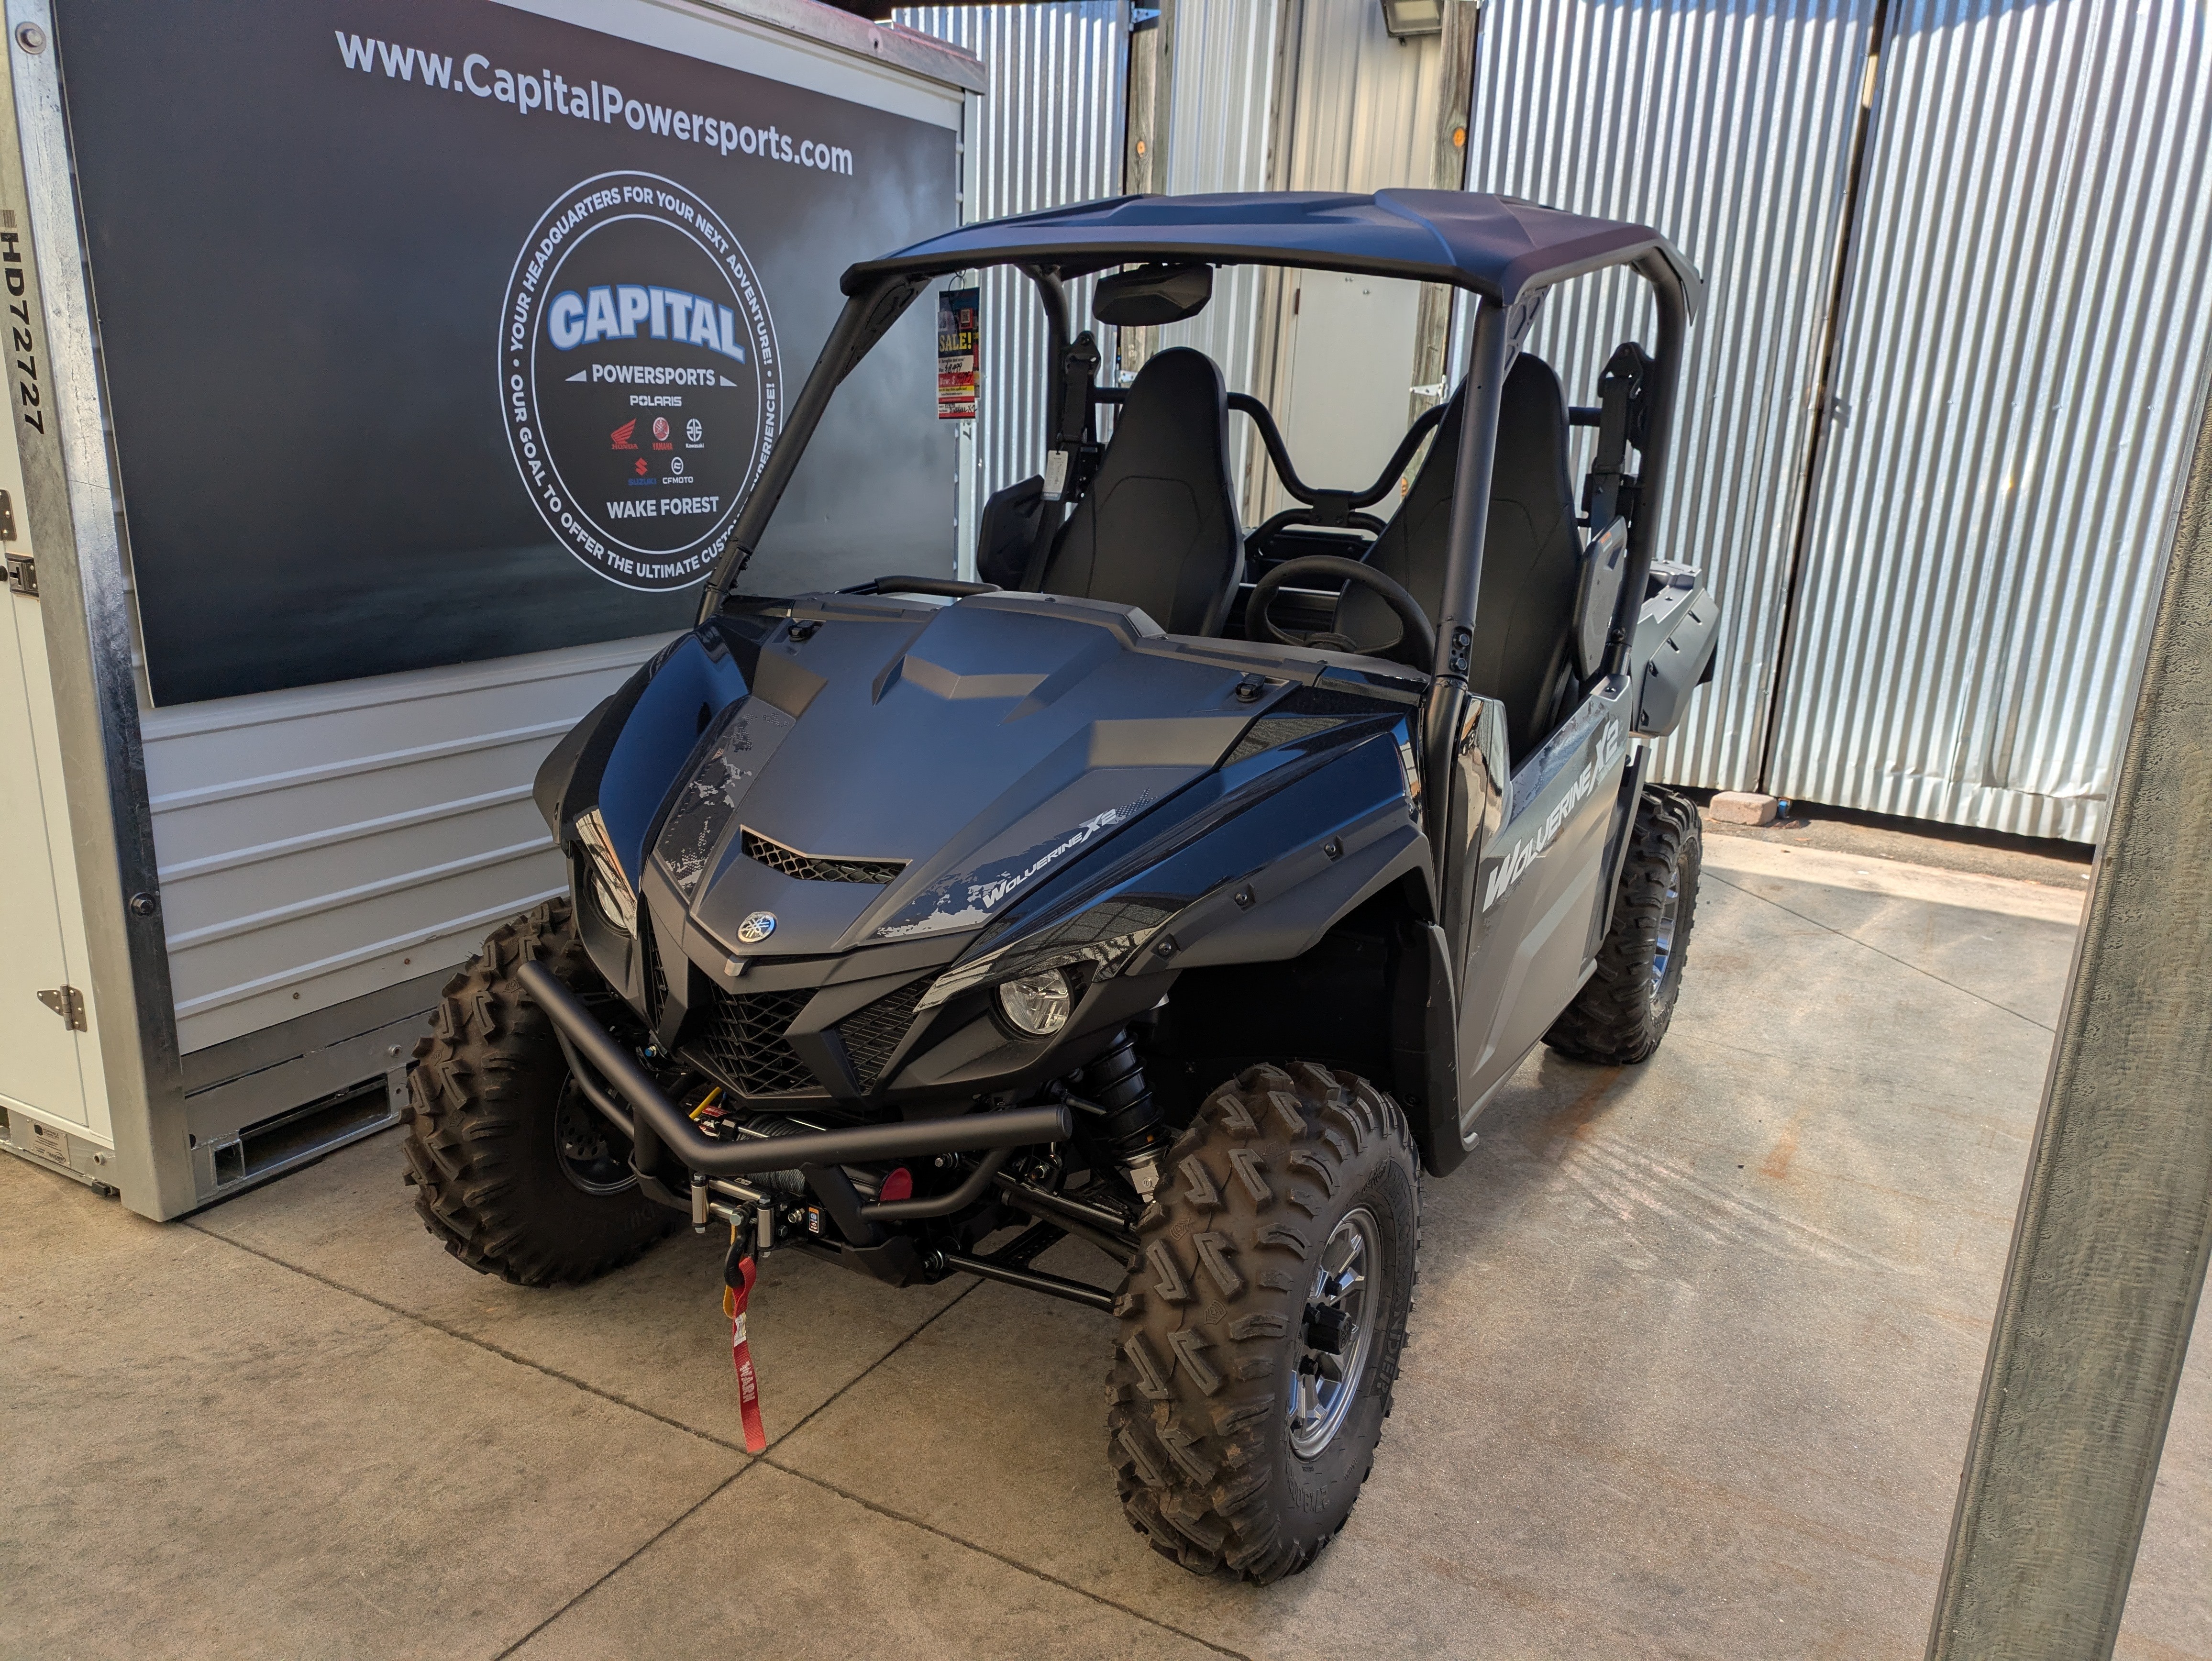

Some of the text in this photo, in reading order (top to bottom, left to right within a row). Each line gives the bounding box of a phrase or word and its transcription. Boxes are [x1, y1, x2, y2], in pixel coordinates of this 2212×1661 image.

[334, 30, 853, 176] www.CapitalPowersports.com
[510, 186, 773, 365] YOUR HEADQUARTERS FOR YOUR NEXT ADVENTURE!
[0, 233, 44, 435] HD72727
[548, 284, 746, 364] CAPITAL
[940, 332, 972, 352] SALE!
[592, 364, 716, 387] POWERSPORTS
[630, 395, 682, 407] POLARIS
[652, 442, 673, 450] YAMAHA
[510, 375, 528, 422] OUR
[519, 426, 544, 487] GOAL
[543, 483, 563, 513] TO
[561, 513, 605, 560] OFFER
[607, 550, 634, 575] THE
[636, 555, 700, 578] ULTIMATE
[606, 496, 719, 519] WAKE FOREST
[740, 1361, 755, 1403] WARN
